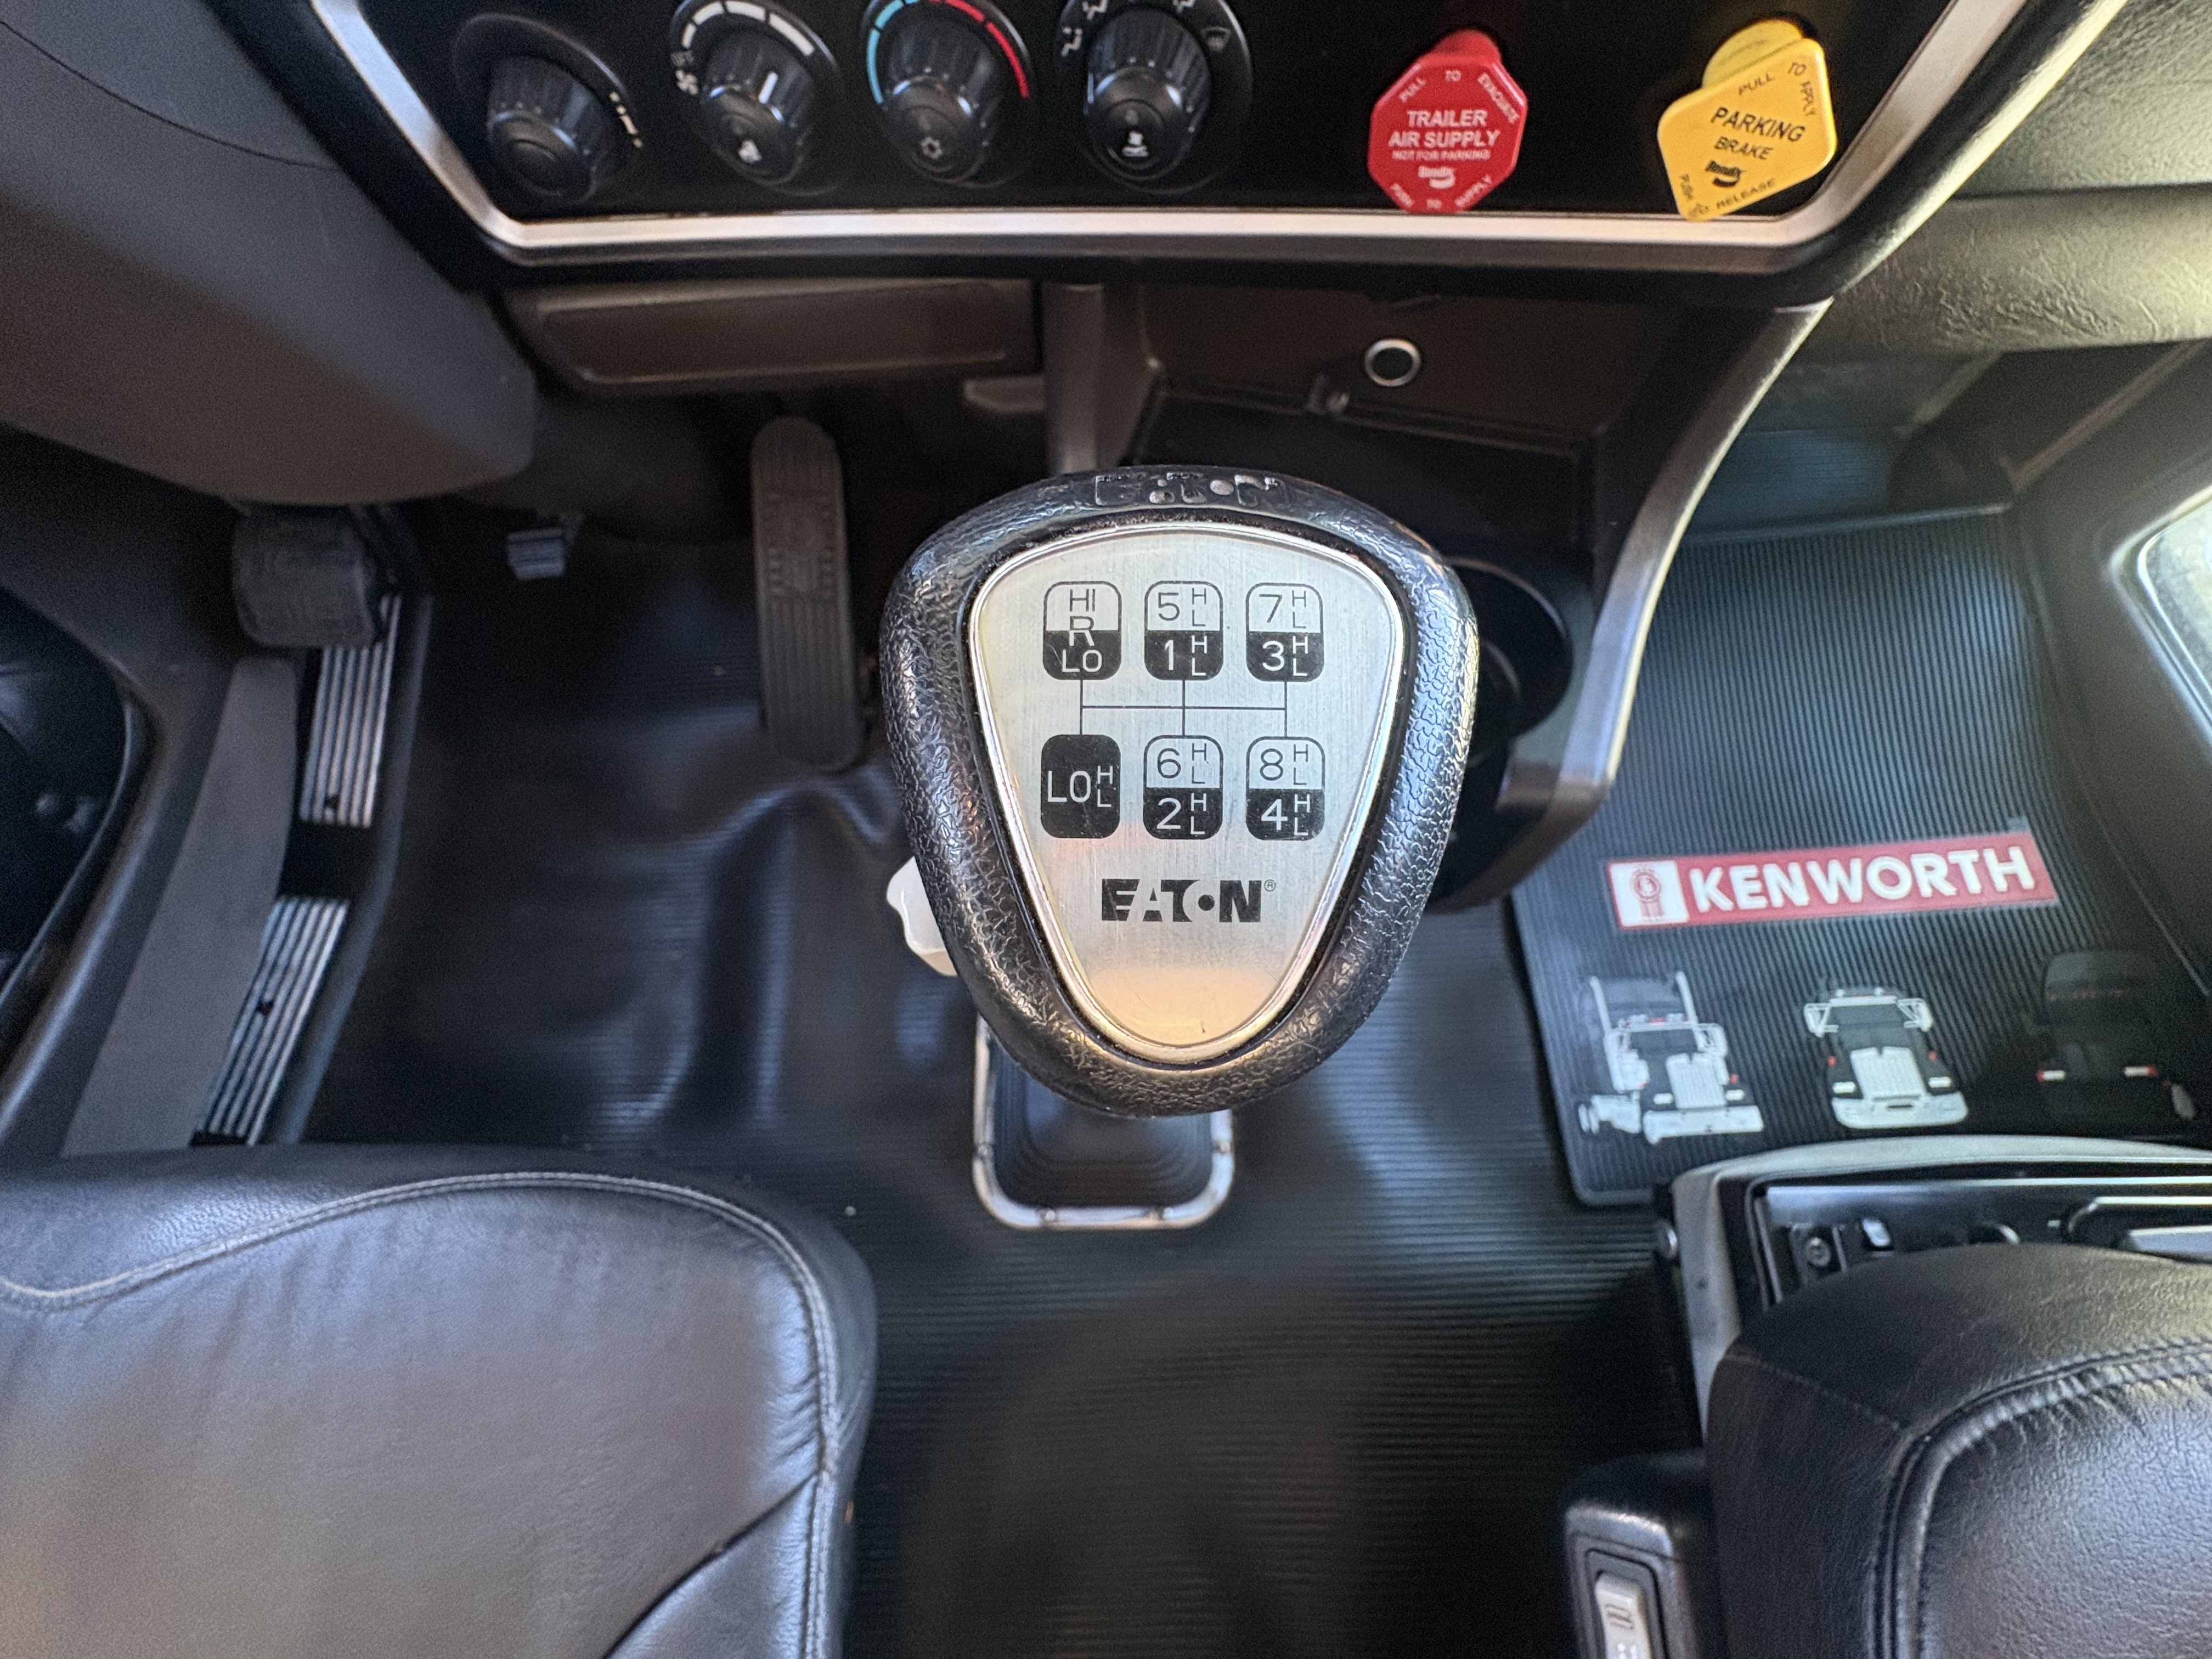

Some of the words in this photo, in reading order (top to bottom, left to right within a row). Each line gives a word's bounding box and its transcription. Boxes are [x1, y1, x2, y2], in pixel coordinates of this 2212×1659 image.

[1737, 71, 1774, 97] PULL
[1407, 110, 1488, 127] TRAILER
[1710, 106, 1806, 143] PARKING
[1387, 131, 1421, 148] AIR
[1423, 129, 1501, 148] SUPPLY
[1714, 136, 1774, 160] BRAKE
[1070, 589, 1096, 612] HI
[1192, 588, 1206, 605] H
[1292, 590, 1306, 607] H
[1158, 592, 1180, 621] 5
[1259, 594, 1283, 623] 7
[1192, 610, 1206, 627] L
[1293, 612, 1307, 628] L
[1069, 616, 1095, 646] R
[1192, 635, 1207, 654] H
[1293, 636, 1308, 654] H
[1062, 649, 1103, 673] LO
[1165, 640, 1174, 671] 1
[1262, 641, 1284, 671] 3
[1192, 658, 1206, 676] L
[1293, 658, 1307, 676] L
[1192, 743, 1206, 761] H
[1294, 744, 1308, 762] H
[1157, 748, 1181, 778] 6
[1260, 748, 1283, 781] 8
[1191, 766, 1205, 784] L
[1294, 768, 1307, 785] L
[1191, 793, 1206, 811] H
[1294, 794, 1310, 812] H
[1156, 798, 1181, 829] 2
[1261, 799, 1288, 830] 4
[1190, 816, 1205, 834] L
[1294, 817, 1308, 836] L
[1689, 845, 2035, 913] KENWORTH
[1101, 878, 1262, 923] EATON
